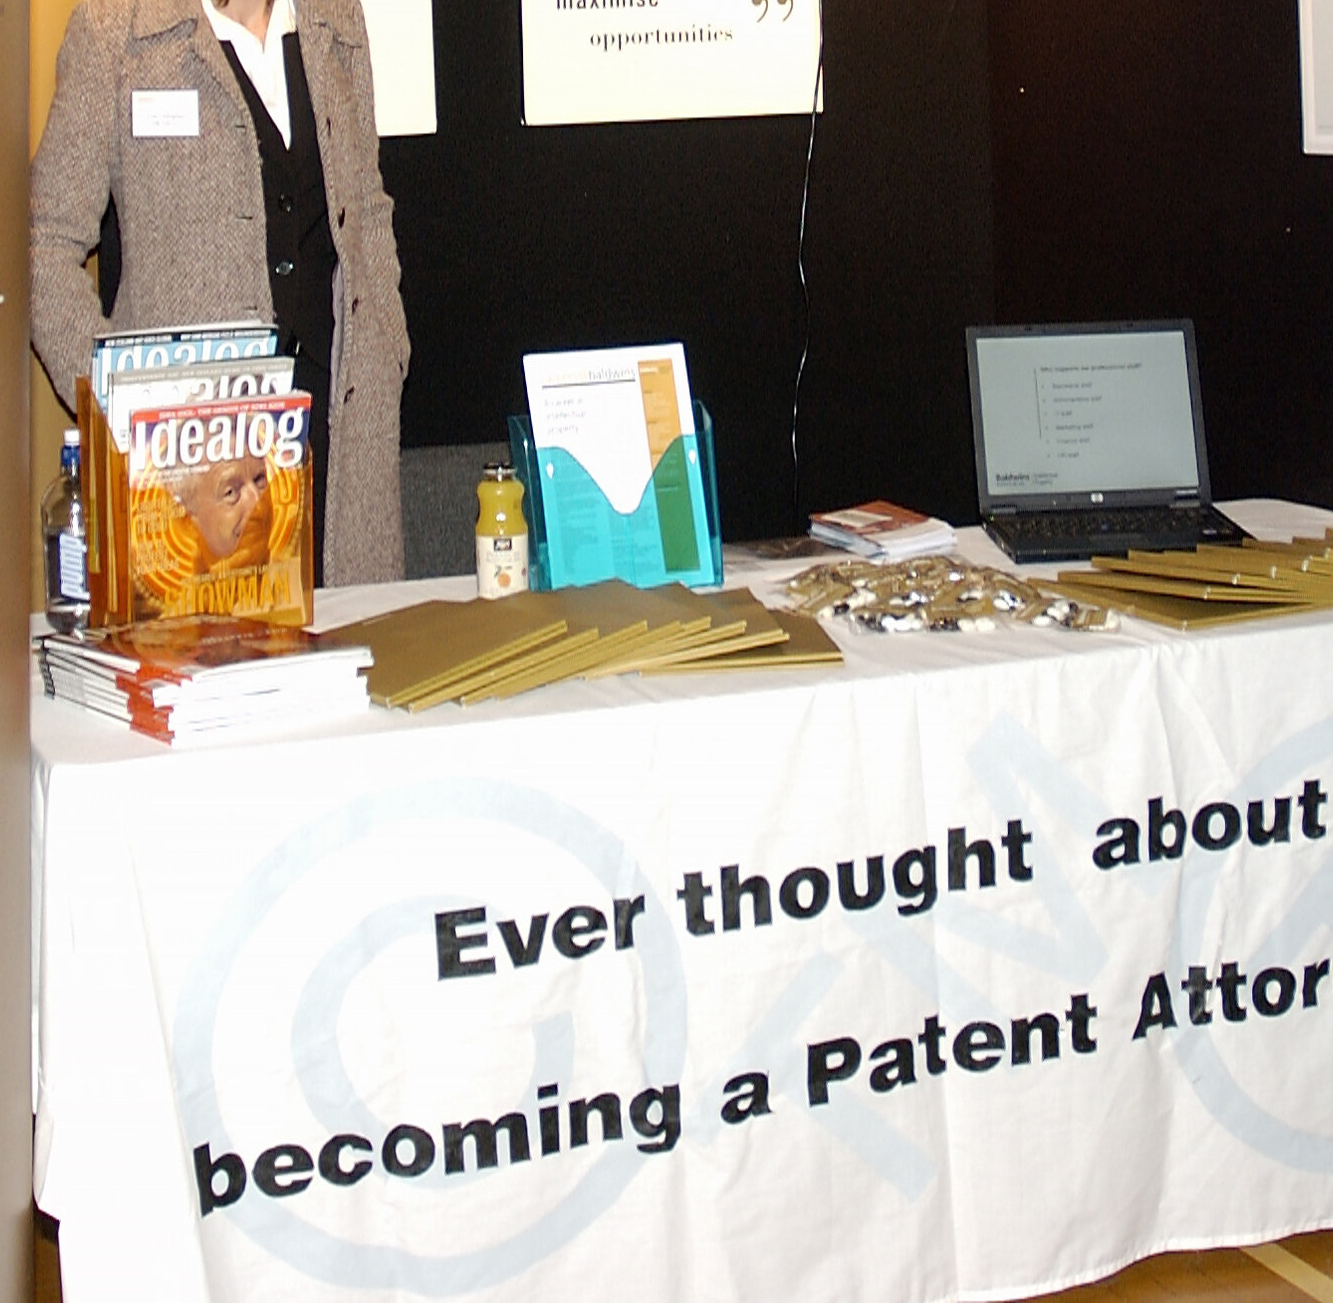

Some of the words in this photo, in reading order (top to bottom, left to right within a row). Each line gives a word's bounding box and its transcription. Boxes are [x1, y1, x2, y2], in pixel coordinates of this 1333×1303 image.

[589, 24, 734, 52] opportunities
[130, 406, 306, 471] Idealog
[59, 532, 91, 601] pump
[165, 568, 292, 618] SHOWMAN
[433, 893, 646, 982] Ever
[675, 818, 1034, 937] thought
[1090, 779, 1330, 871] about
[192, 1081, 683, 1218] becoming
[719, 1068, 773, 1125] a
[806, 993, 1099, 1107] Patent
